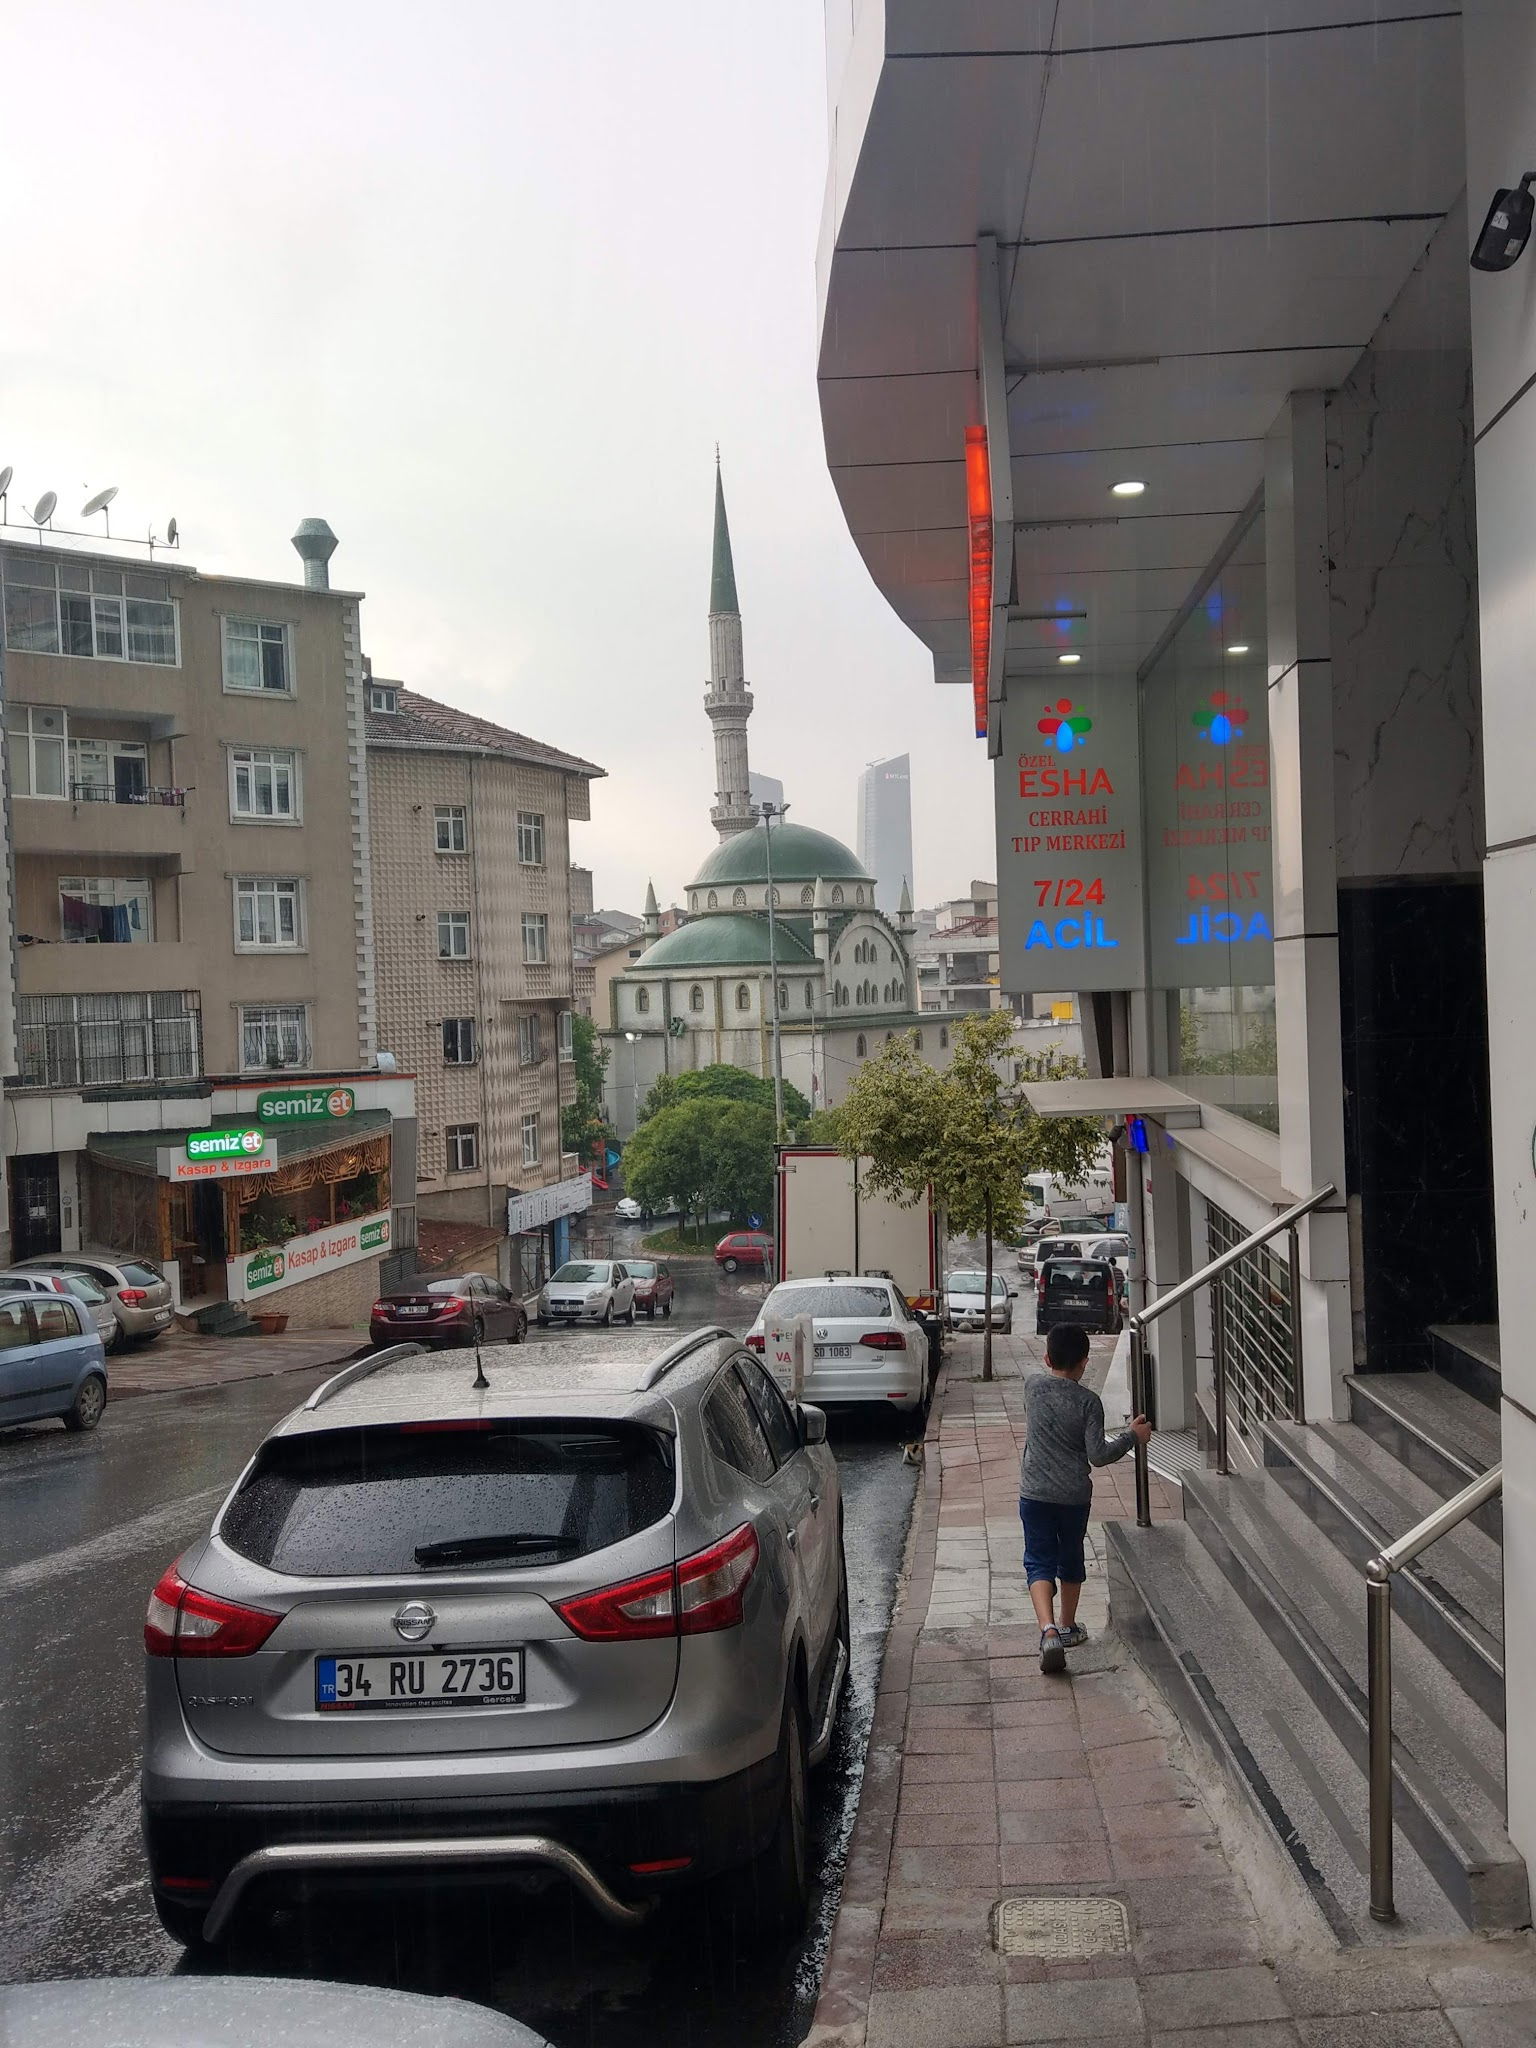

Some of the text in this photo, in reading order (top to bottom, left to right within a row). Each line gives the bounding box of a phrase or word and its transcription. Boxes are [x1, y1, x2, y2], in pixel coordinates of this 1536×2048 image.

[1018, 753, 1056, 768] ÖZEL
[1019, 768, 1115, 798] ESHA
[1029, 805, 1108, 827] CERRAHİ
[1011, 830, 1127, 853] TIP MERKEZİ
[1034, 878, 1106, 907] 7/24
[1025, 909, 1119, 950] ACİL
[262, 1090, 351, 1116] semiz et
[189, 1132, 261, 1154] semiz et
[177, 1158, 271, 1177] Kasap & Izgara
[247, 1222, 389, 1284] semiz et Kasap & Izgara semiz et
[814, 1347, 825, 1357] SD
[397, 1618, 431, 1626] NISSAN
[337, 1657, 514, 1698] 34 RU 2736
[321, 1684, 335, 1694] TR
